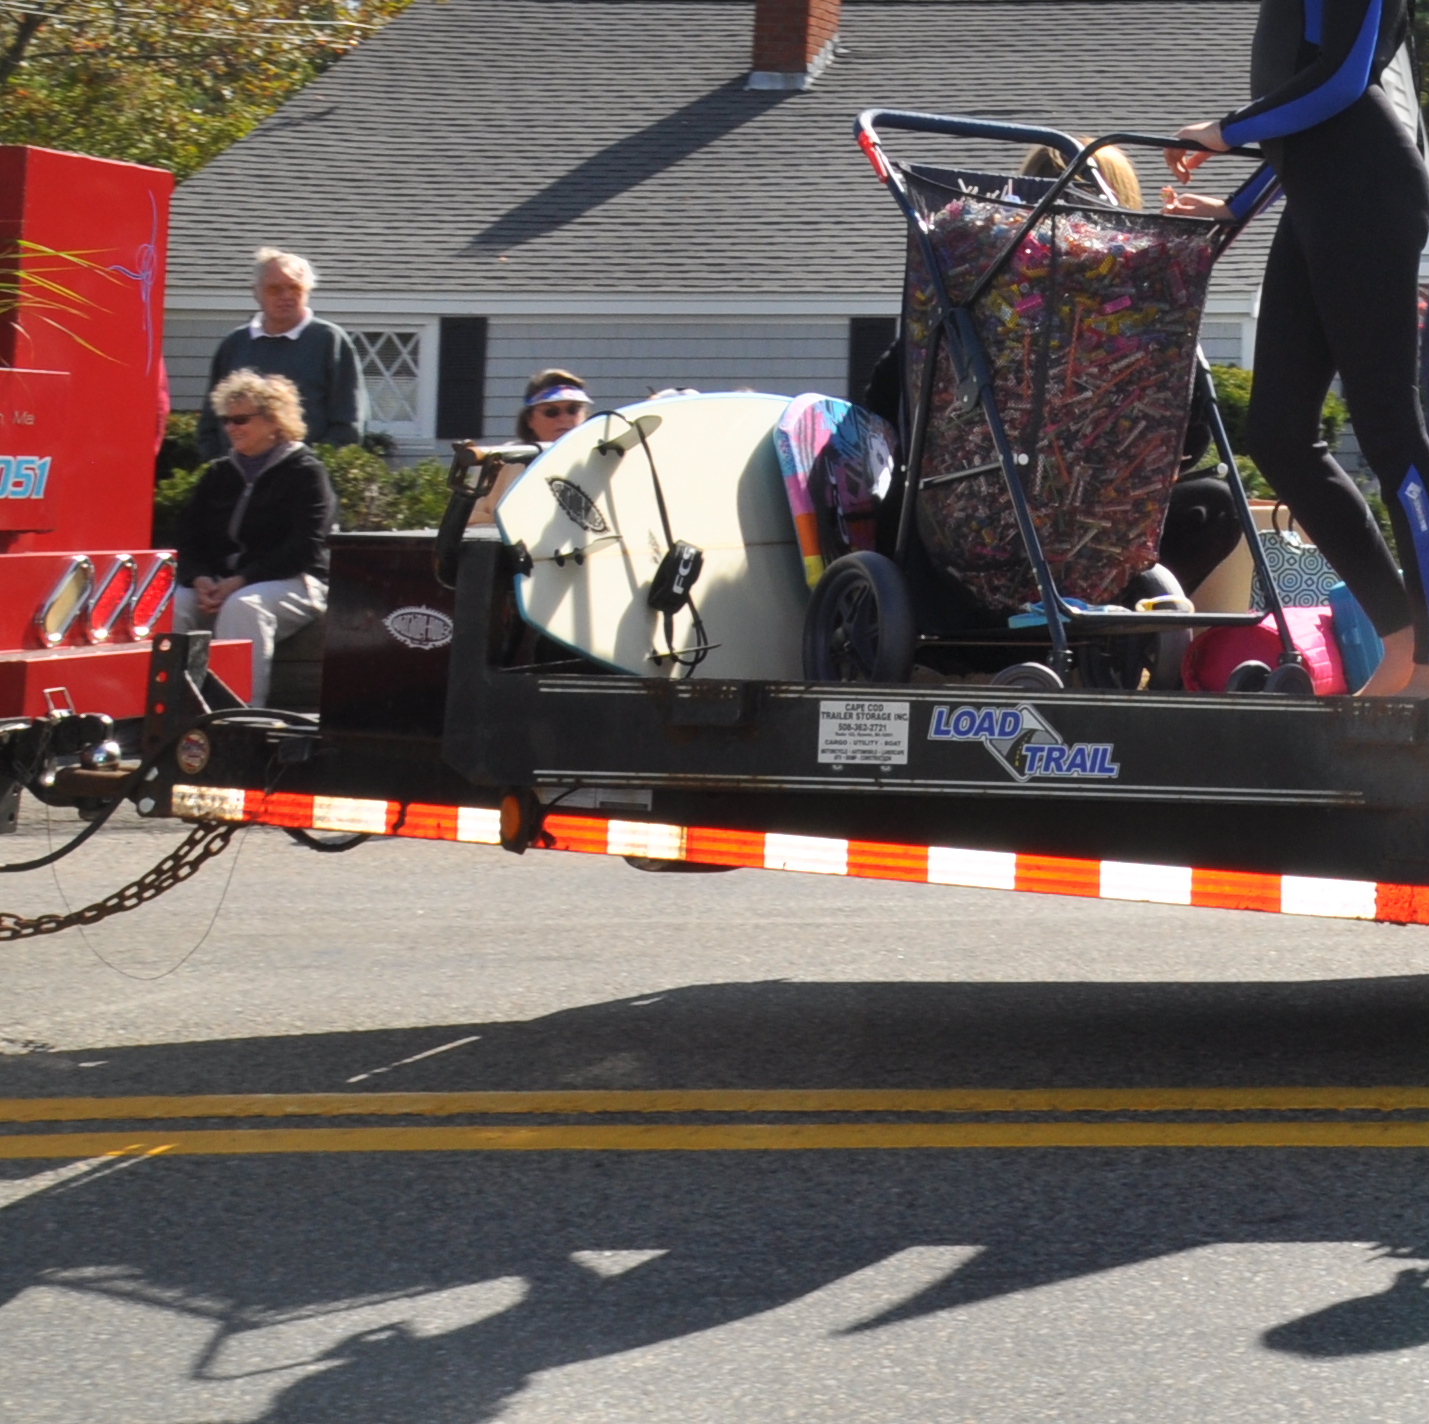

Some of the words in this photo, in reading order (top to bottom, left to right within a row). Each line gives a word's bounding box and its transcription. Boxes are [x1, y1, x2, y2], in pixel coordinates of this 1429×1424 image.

[672, 546, 696, 595] FCS
[821, 711, 854, 721] TRAILER
[856, 712, 892, 721] STORAGE
[845, 703, 865, 712] CAPE
[867, 703, 884, 712] COD
[931, 708, 1023, 739] LOAD
[1022, 744, 1119, 776] TRAIL
